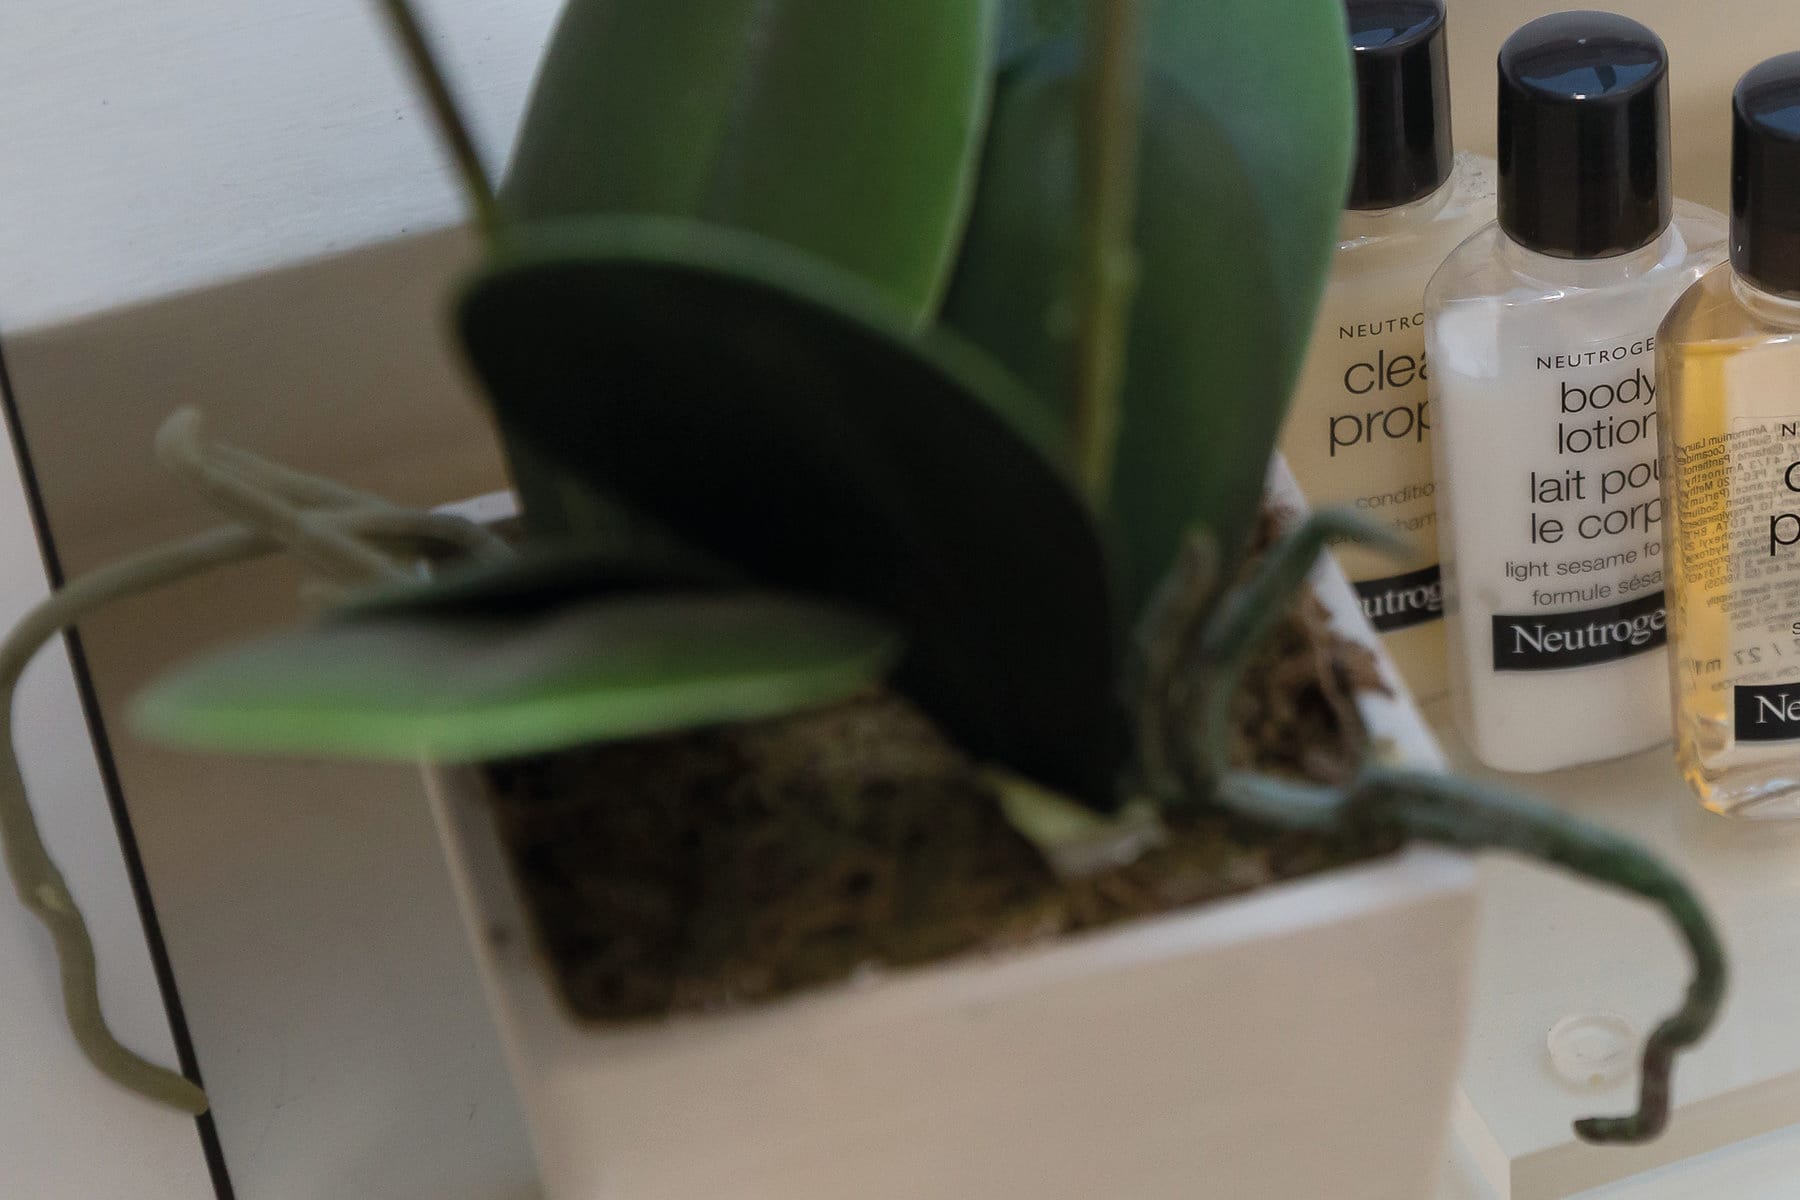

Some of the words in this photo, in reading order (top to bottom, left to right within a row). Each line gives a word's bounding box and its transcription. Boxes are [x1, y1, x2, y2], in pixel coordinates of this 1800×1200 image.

[1561, 367, 1656, 414] body
[1531, 469, 1586, 503] lait
[1531, 512, 1564, 544] le
[1505, 561, 1549, 582] light
[1556, 550, 1638, 576] sesame
[1532, 584, 1612, 606] formule
